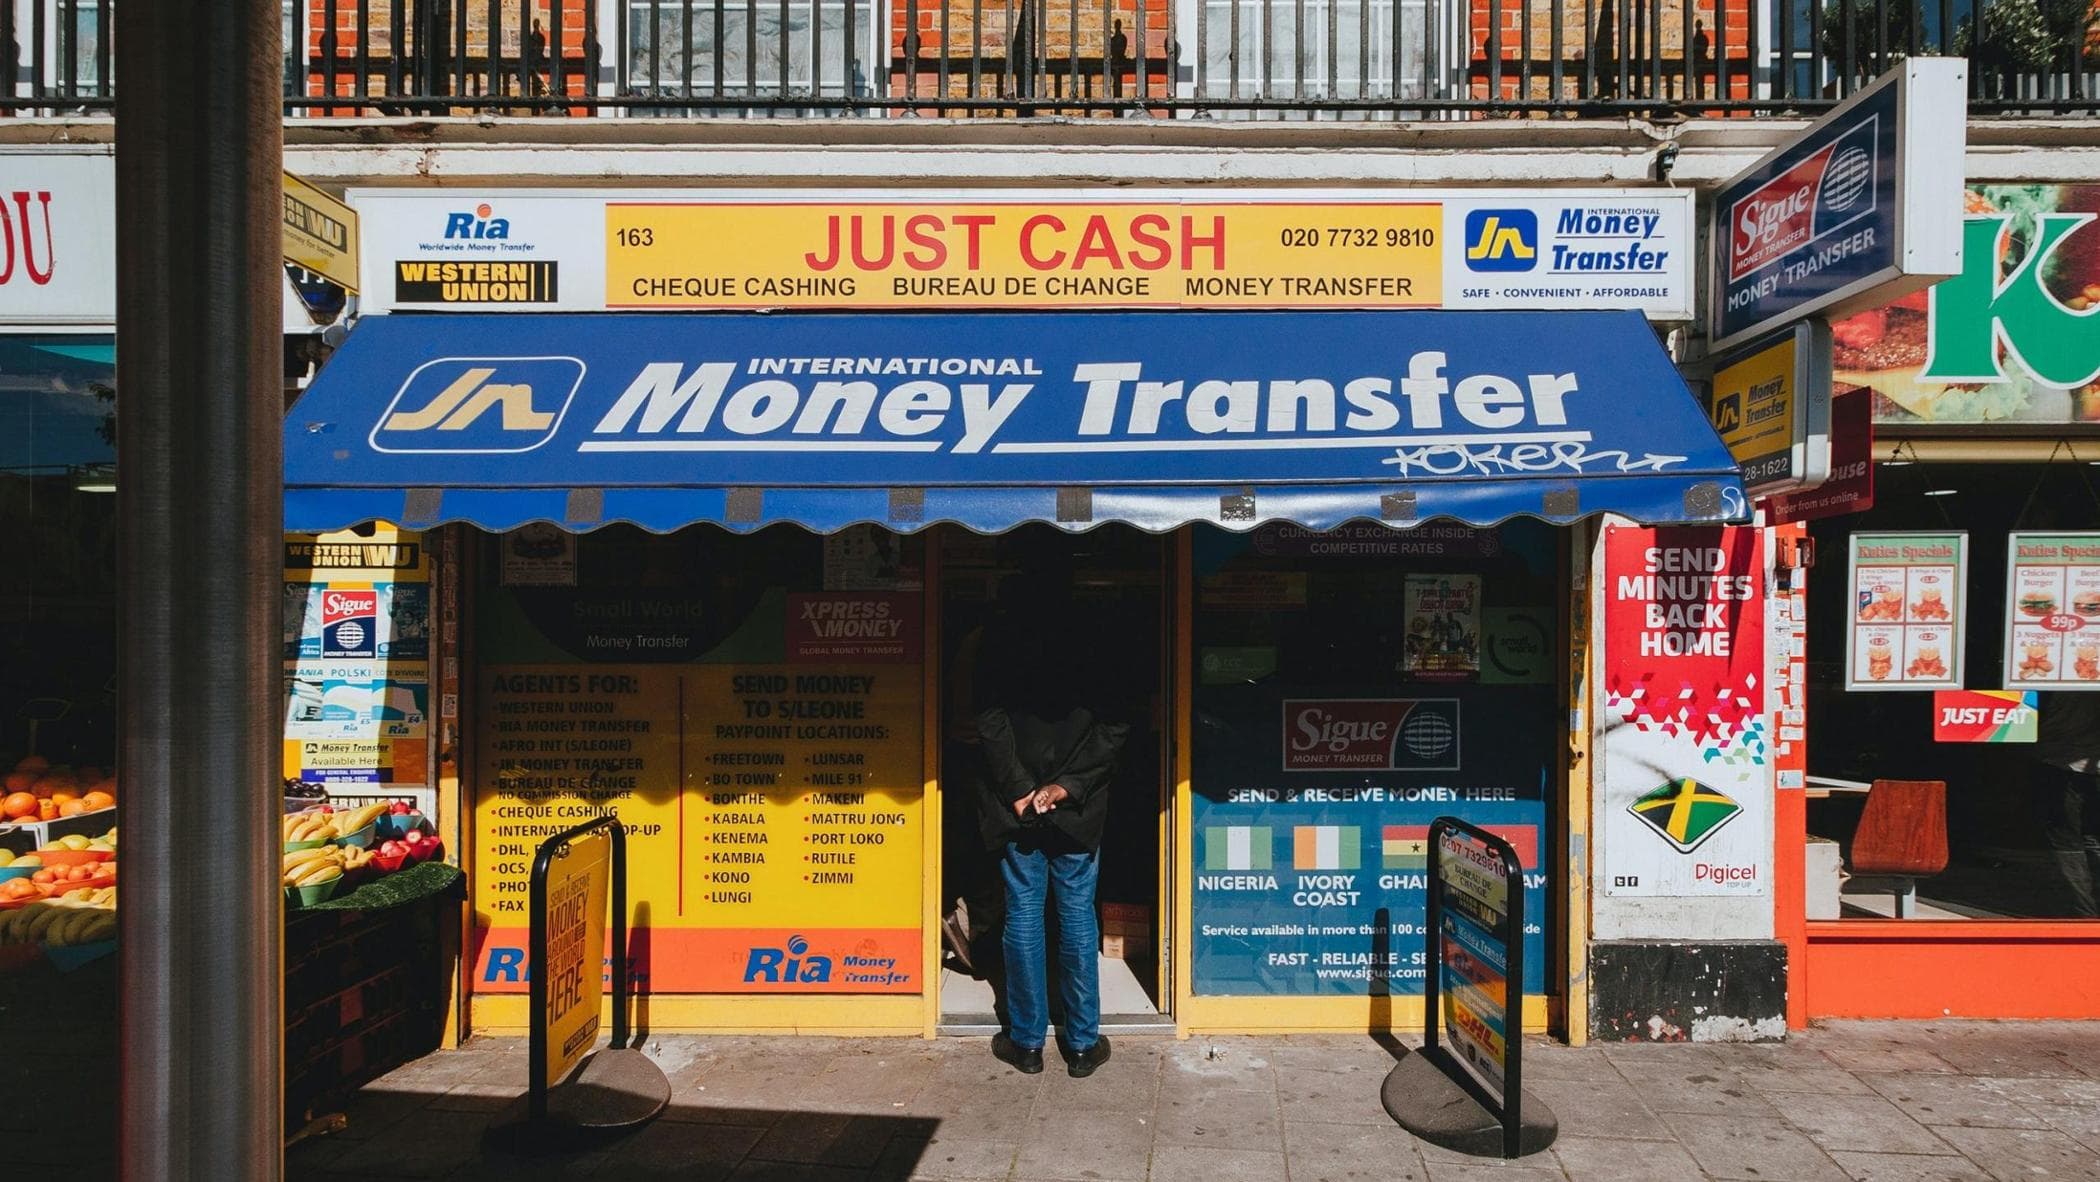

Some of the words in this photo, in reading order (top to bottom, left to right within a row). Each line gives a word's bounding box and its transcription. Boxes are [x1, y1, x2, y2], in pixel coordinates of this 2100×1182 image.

[1587, 208, 1661, 216] INTERNATIONAL
[445, 204, 510, 240] Ria
[1556, 208, 1661, 240] Money
[1736, 185, 1810, 256] Sigue
[616, 228, 654, 247] 163
[805, 214, 996, 271] JUST
[1019, 214, 1226, 271] CASH
[1280, 228, 1322, 248] 020
[1328, 228, 1379, 248] 7732
[1384, 228, 1435, 248] 9810
[419, 243, 464, 252] Worldwide
[468, 243, 496, 253] Money
[500, 243, 535, 252] Transfer
[1736, 250, 1763, 272] MONEY
[1765, 227, 1806, 256] TRANSFER
[1551, 243, 1669, 272] Transfer
[401, 263, 527, 282] WESTERN
[1728, 273, 1780, 312] MONEY
[1785, 227, 1876, 285] TRANSFER
[442, 283, 527, 301] UNION
[632, 277, 741, 298] CHEQUE
[746, 277, 856, 297] CASHING
[893, 277, 999, 297] BUREAU
[1002, 277, 1039, 297] DE
[1045, 277, 1151, 297] CHANGE
[1185, 277, 1275, 297] MONEY
[1280, 277, 1412, 297] TRANSFER
[1462, 288, 1490, 299] SAFE
[1503, 288, 1581, 299] CONVENIENT
[1592, 288, 1669, 299] AFFORDABLE
[747, 357, 1043, 377] INTERNATIONAL
[1747, 377, 1785, 403] Money
[592, 361, 1035, 454] Money
[1072, 350, 1581, 436] Transfer
[1746, 398, 1787, 424] Transfer
[1799, 498, 1818, 512] from
[1819, 495, 1829, 506] us
[1830, 491, 1859, 505] online
[1432, 527, 1475, 539] INSIDE
[288, 544, 362, 556] WESTERN
[1310, 543, 1398, 555] COMPETITIVE
[1402, 543, 1444, 555] RATES
[1857, 544, 1899, 558] Katies
[1902, 544, 1953, 562] Specials
[2017, 544, 2058, 558] Katies
[312, 556, 362, 567] UNION
[1645, 547, 1726, 572] SEND
[2020, 569, 2057, 577] Chicken
[1618, 576, 1753, 601] MINUTES
[2024, 579, 2054, 588] Burger
[325, 593, 374, 616] Sigue
[800, 600, 891, 619] XPRESS
[1646, 604, 1726, 628] BACK
[820, 619, 904, 638] MONEY
[2050, 616, 2077, 631] 99p
[586, 634, 632, 650] Money
[636, 634, 690, 648] Transfer
[1640, 631, 1731, 657] HOME
[832, 647, 859, 655] MONEY
[331, 668, 371, 677] POLSKI
[495, 675, 581, 693] AGENTS
[588, 675, 639, 693] FOR:
[733, 676, 788, 694] SEND
[796, 676, 875, 694] MONEY
[499, 701, 566, 714] WESTERN
[569, 701, 614, 714] UNION
[743, 699, 771, 718] TO
[778, 699, 865, 720] S/LEONE
[1940, 707, 1990, 727] JUST
[1992, 707, 2029, 726] EAT
[388, 722, 410, 735] Ria
[499, 720, 522, 732] RIA
[526, 720, 576, 732] MONEY
[581, 720, 651, 732] TRANSFER
[716, 726, 791, 740] PAYPOINT
[797, 726, 890, 740] LOCATIONS:
[1292, 707, 1387, 752] Sigue
[321, 743, 351, 753] Money
[353, 743, 390, 752] Transfer
[499, 739, 535, 751] AFRO
[540, 739, 562, 751] INT
[566, 738, 632, 753] (S/LEONE)
[311, 757, 356, 766] Available
[360, 757, 383, 766] Here
[519, 758, 569, 771] MONEY
[713, 754, 785, 765] FREETOWN
[812, 754, 864, 765] LUNSAR
[1292, 754, 1330, 764] MONEY
[1333, 754, 1384, 764] TRANSFER
[499, 777, 553, 789] BUREAU
[558, 777, 577, 789] DE
[580, 777, 637, 789] CHANGE
[713, 774, 731, 785] BO
[736, 774, 775, 785] TOWN
[812, 774, 844, 785] MILE
[848, 774, 862, 785] 91
[499, 790, 514, 799] NO
[518, 790, 588, 799] COMMISSION
[590, 790, 632, 799] CHARGE
[713, 793, 764, 805] BONTHE
[812, 793, 864, 805] MAKENI
[1228, 787, 1279, 802] SEND
[1287, 787, 1298, 802] &
[1304, 787, 1383, 802] RECEIVE
[1390, 787, 1460, 802] MONEY
[1466, 787, 1516, 802] HERE
[499, 806, 552, 819] CHEQUE
[557, 806, 619, 818] CASHING
[712, 813, 766, 825] KABALA
[812, 813, 866, 825] MATTRU
[870, 813, 905, 825] JONG
[712, 833, 768, 844] KENEMA
[812, 833, 846, 845] PORT
[850, 833, 885, 845] LOKO
[499, 844, 529, 857] DHL,
[1441, 835, 1462, 856] 0207
[1464, 846, 1506, 878] 7329810
[712, 853, 766, 864] KAMBIA
[812, 853, 856, 865] RUTILE
[499, 863, 529, 876] OCS,
[1695, 864, 1756, 884] Digicel
[712, 872, 750, 883] KONO
[812, 872, 854, 884] ZIMMI
[1198, 876, 1279, 890] NIGERIA
[1299, 875, 1356, 890] IVORY
[712, 892, 752, 903] LUNGI
[1293, 892, 1361, 906] COAST
[499, 901, 524, 911] FAX
[549, 888, 589, 942] MONEY
[1202, 924, 1247, 936] Service
[1252, 924, 1304, 936] available
[1308, 924, 1319, 936] in
[1323, 926, 1357, 936] more
[1360, 924, 1387, 936] than
[1392, 924, 1412, 936] 100
[743, 935, 833, 984] Ria
[843, 956, 896, 969] Money
[1269, 953, 1309, 966] FAST
[1322, 953, 1398, 966] RELIABLE
[845, 972, 910, 985] Transfer
[1316, 966, 1427, 982] www.sigue.com
